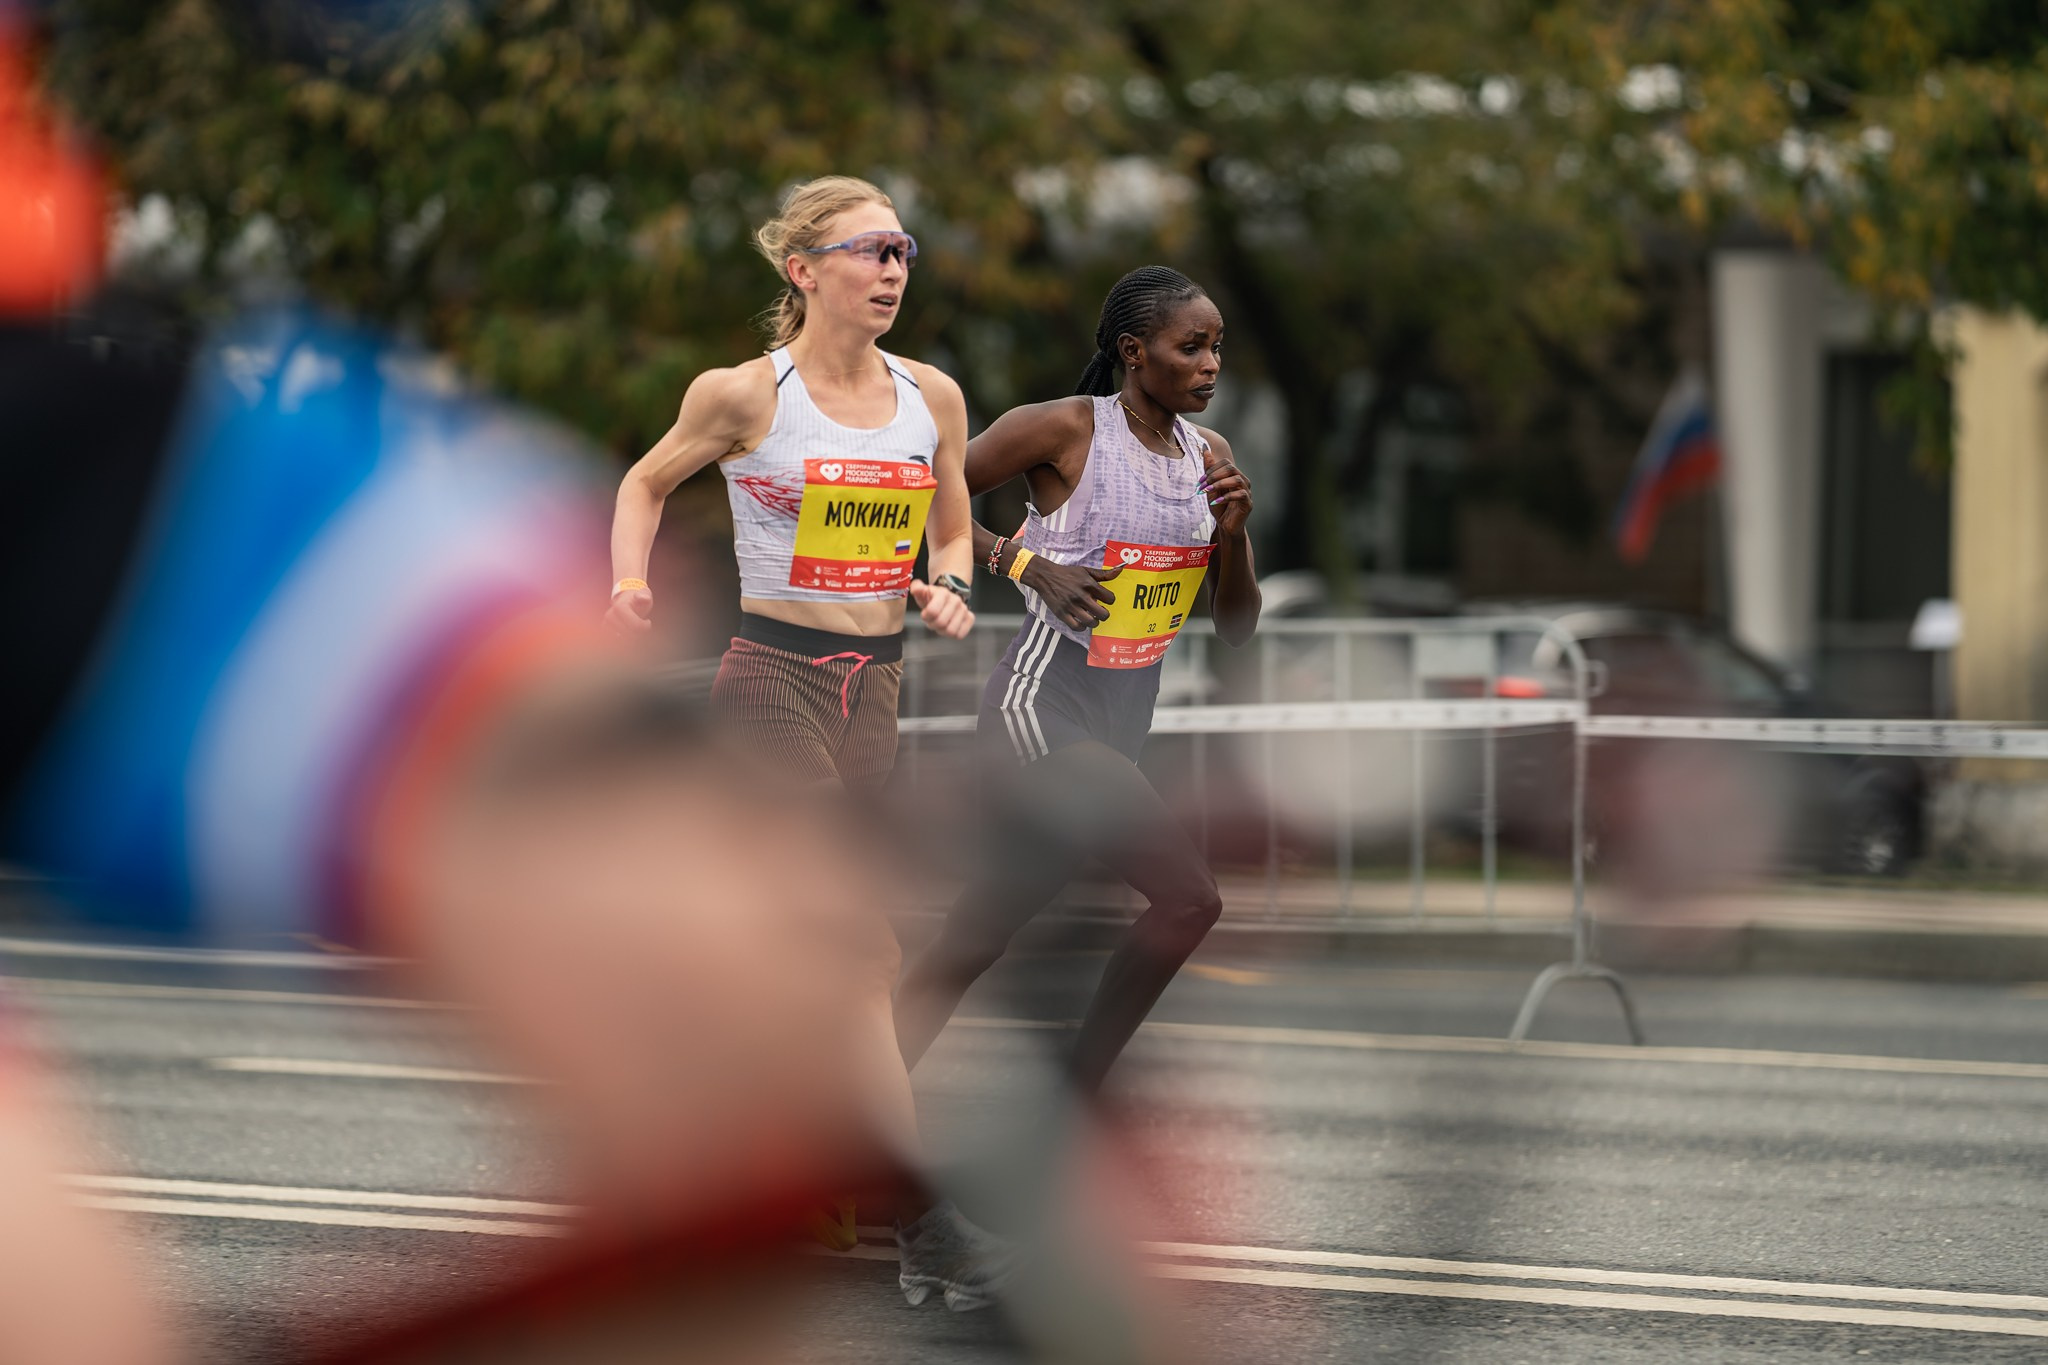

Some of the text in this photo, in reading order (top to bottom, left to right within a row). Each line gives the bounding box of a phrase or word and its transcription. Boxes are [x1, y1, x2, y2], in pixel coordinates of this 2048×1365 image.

[845, 470, 892, 478] МОСКОВСКИЙ
[825, 501, 910, 529] МОКИНА
[857, 544, 869, 555] 33
[1133, 581, 1180, 609] RUTTO
[1147, 623, 1157, 633] 32
